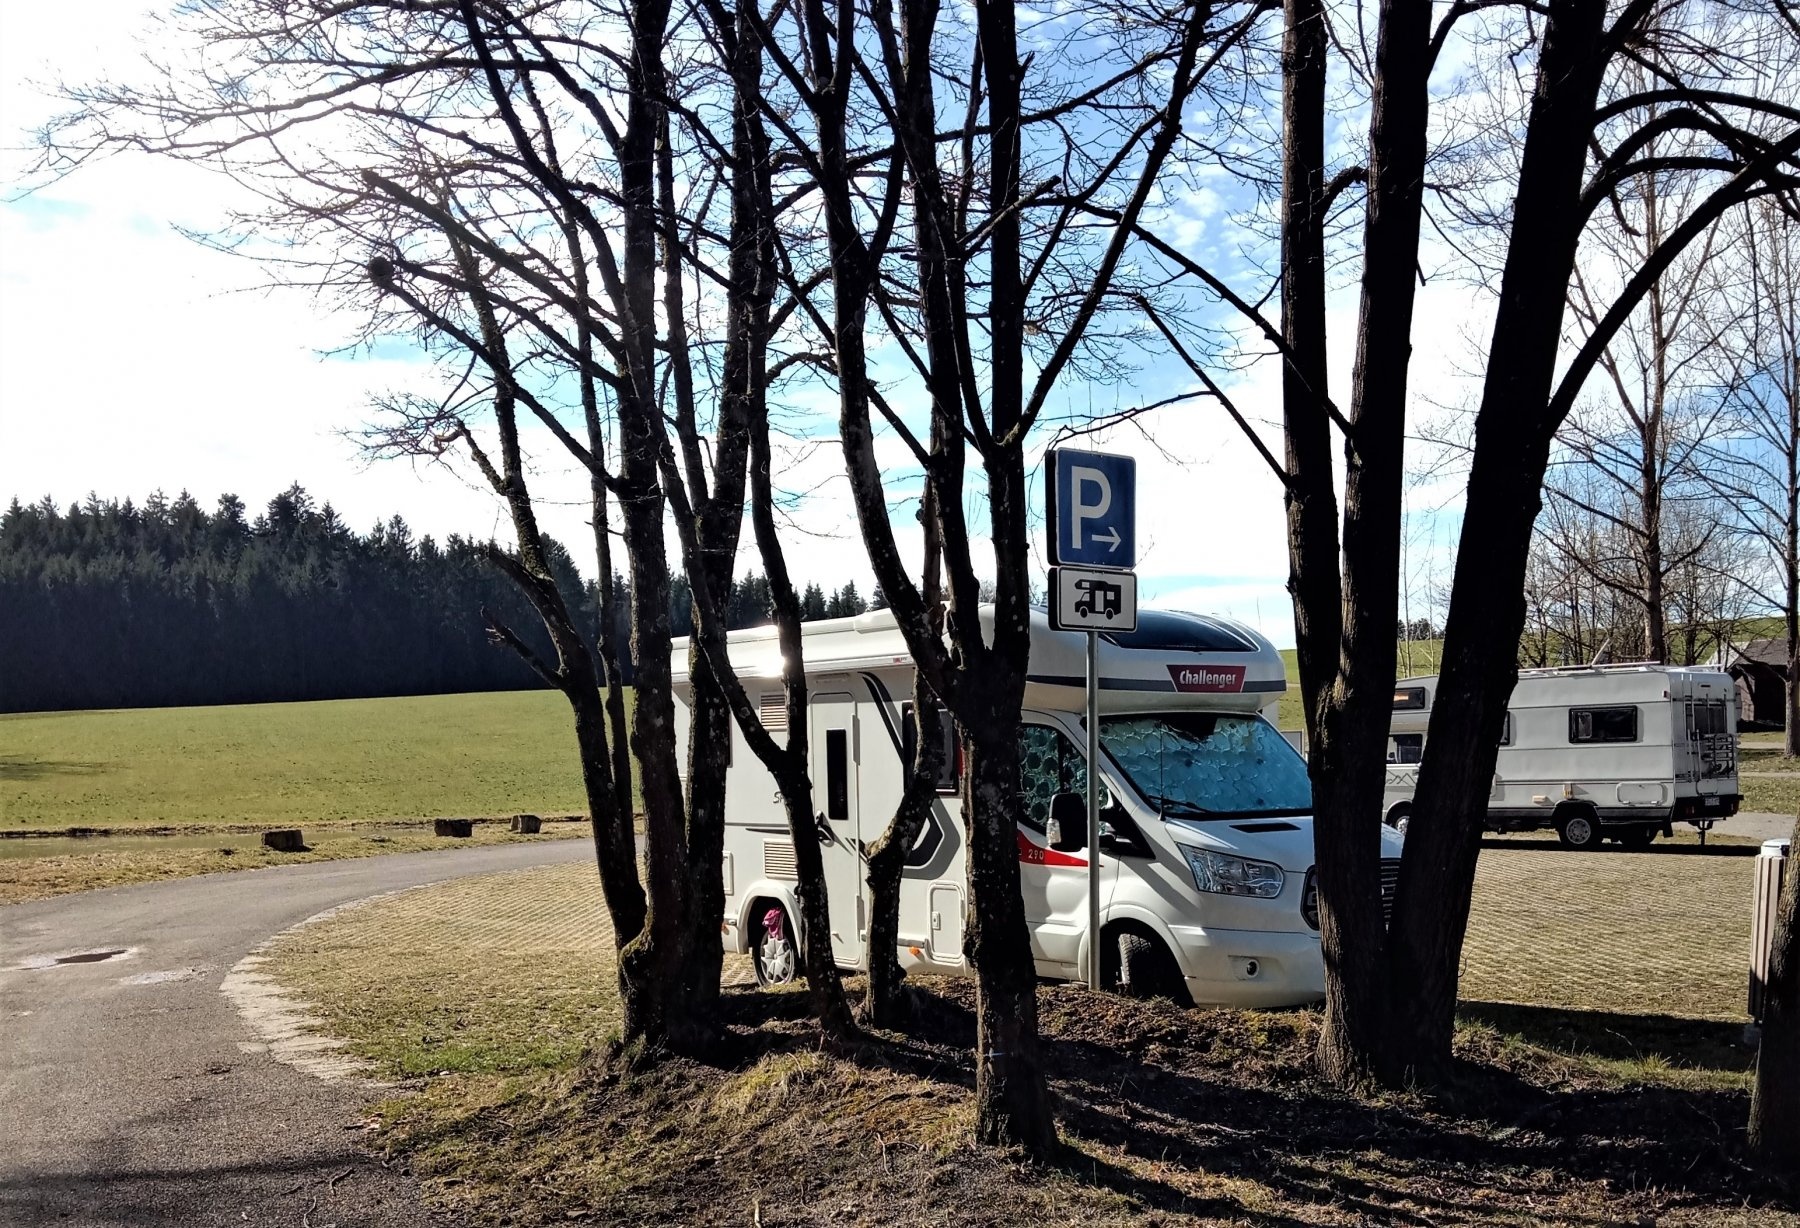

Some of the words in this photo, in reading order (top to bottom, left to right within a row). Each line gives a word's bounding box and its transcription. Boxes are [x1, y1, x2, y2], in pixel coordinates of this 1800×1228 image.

[1071, 465, 1112, 550] P
[1179, 669, 1237, 689] Challenger
[1028, 848, 1045, 860] 290
